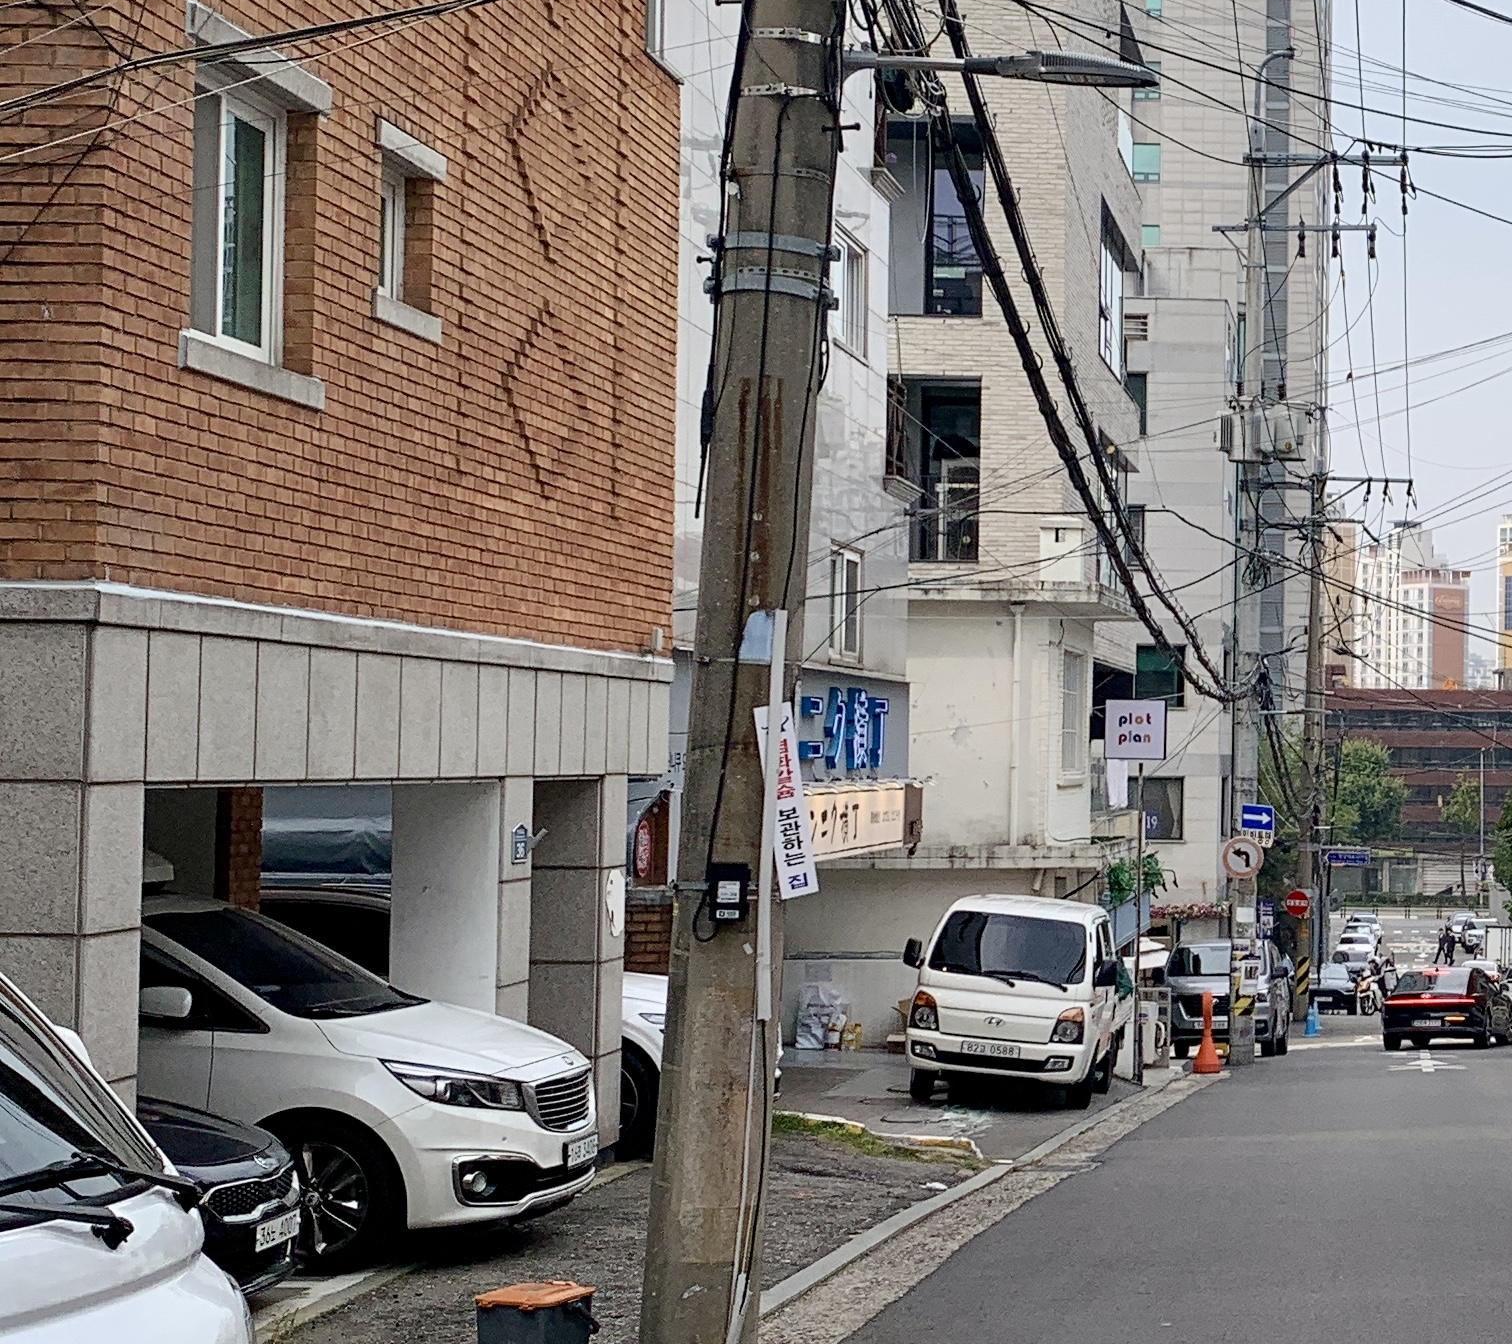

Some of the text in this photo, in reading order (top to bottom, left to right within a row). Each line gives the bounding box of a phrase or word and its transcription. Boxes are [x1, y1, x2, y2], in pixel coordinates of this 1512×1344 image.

[1118, 712, 1152, 728] plot
[1118, 730, 1152, 745] plan
[777, 806, 807, 867] 보관하는
[787, 872, 810, 890] 집
